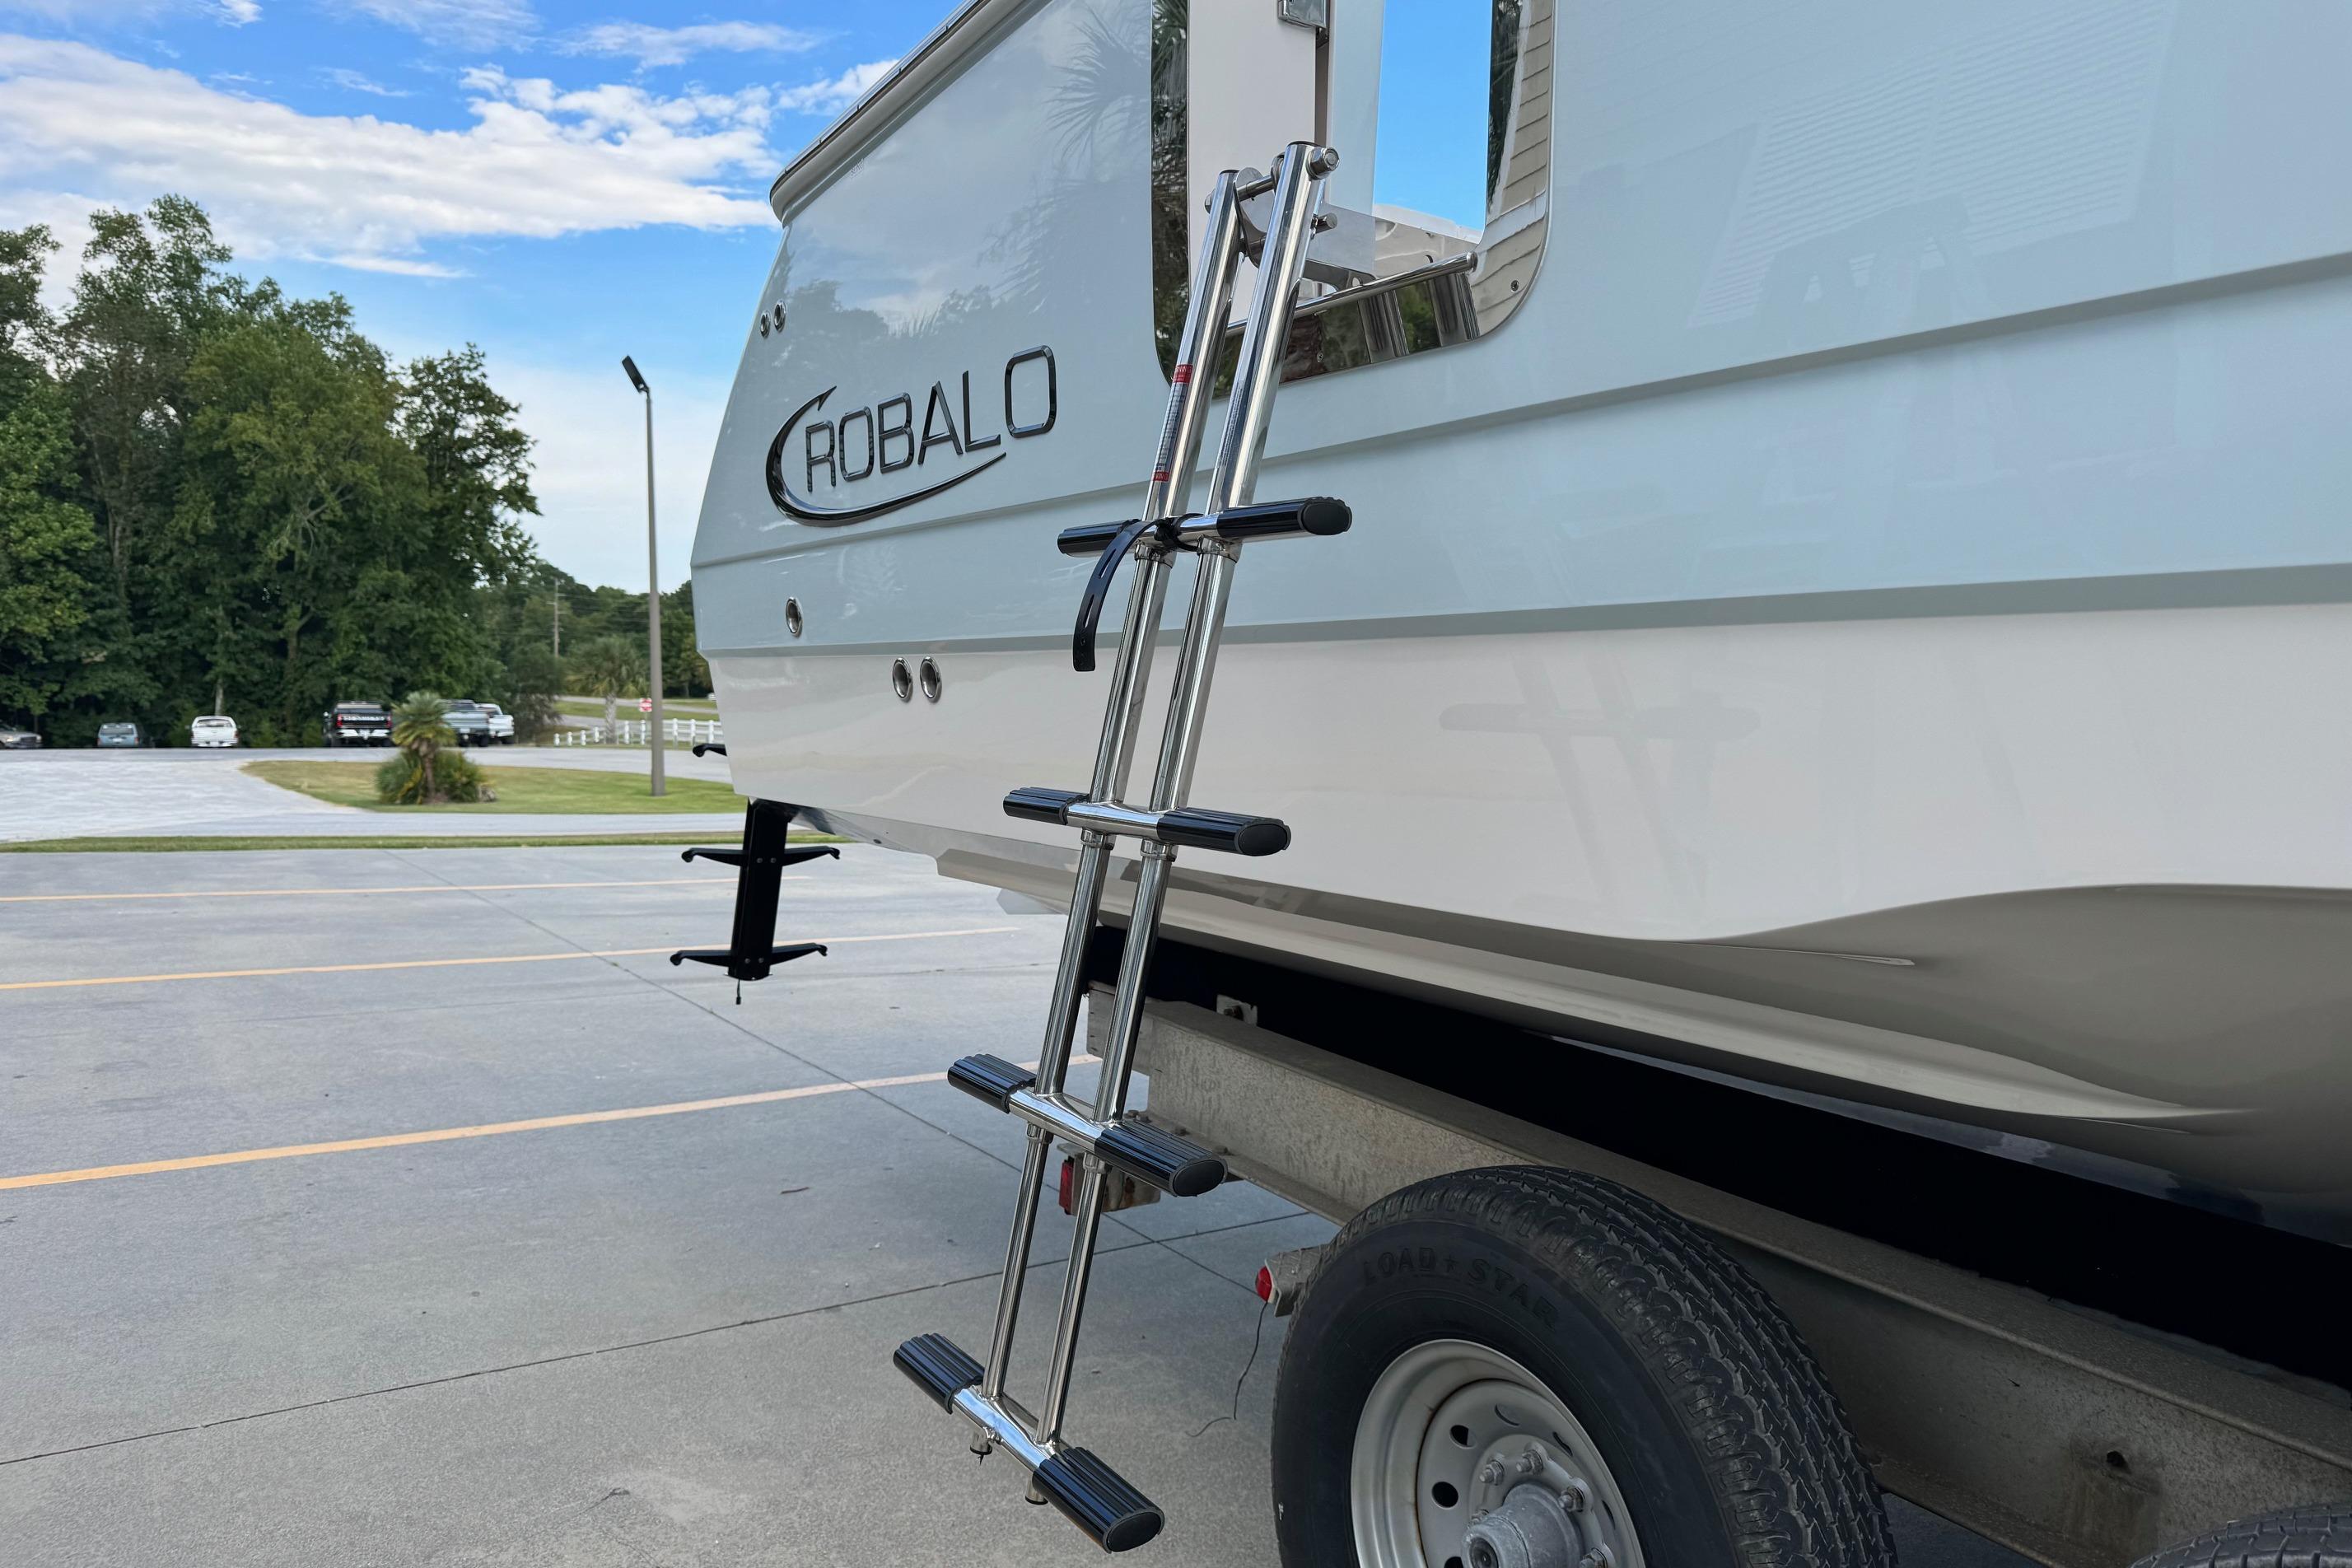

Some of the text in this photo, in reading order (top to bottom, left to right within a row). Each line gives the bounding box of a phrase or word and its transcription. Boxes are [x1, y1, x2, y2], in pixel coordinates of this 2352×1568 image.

[805, 344, 1057, 492] ROBALO
[1363, 1246, 1558, 1332] LOAD STAR
